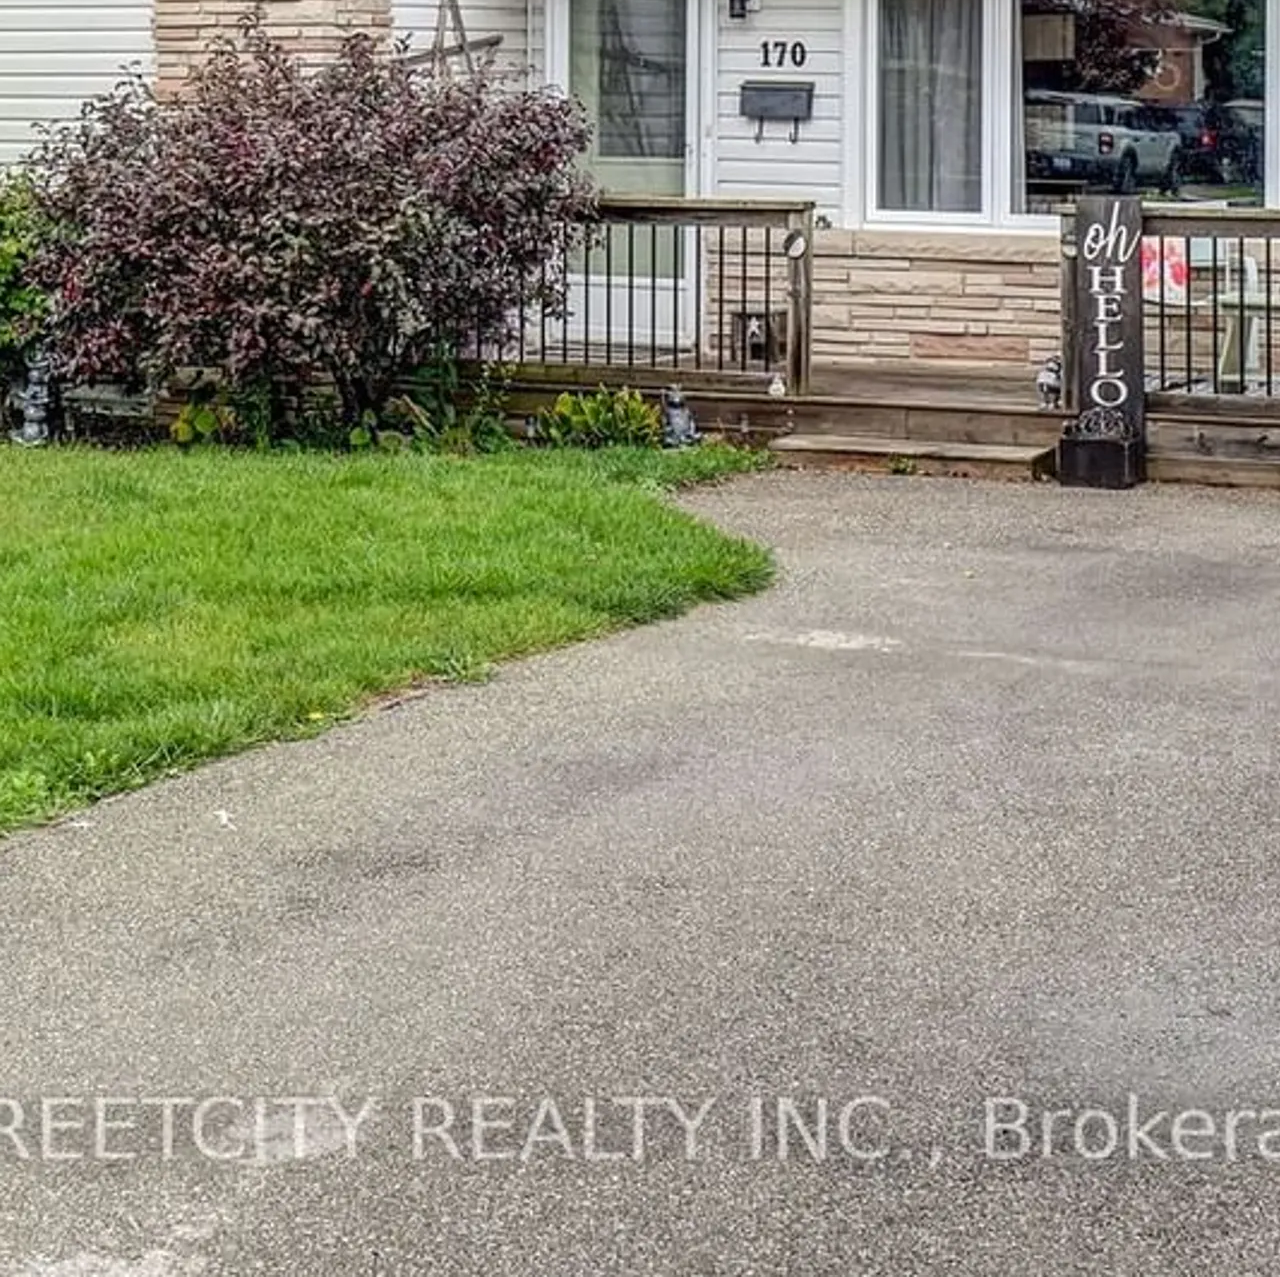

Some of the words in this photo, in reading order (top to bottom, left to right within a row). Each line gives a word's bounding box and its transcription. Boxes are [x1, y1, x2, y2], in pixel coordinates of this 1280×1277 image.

[761, 41, 807, 67] 170
[1083, 201, 1141, 263] oh
[1087, 265, 1128, 407] HELLO
